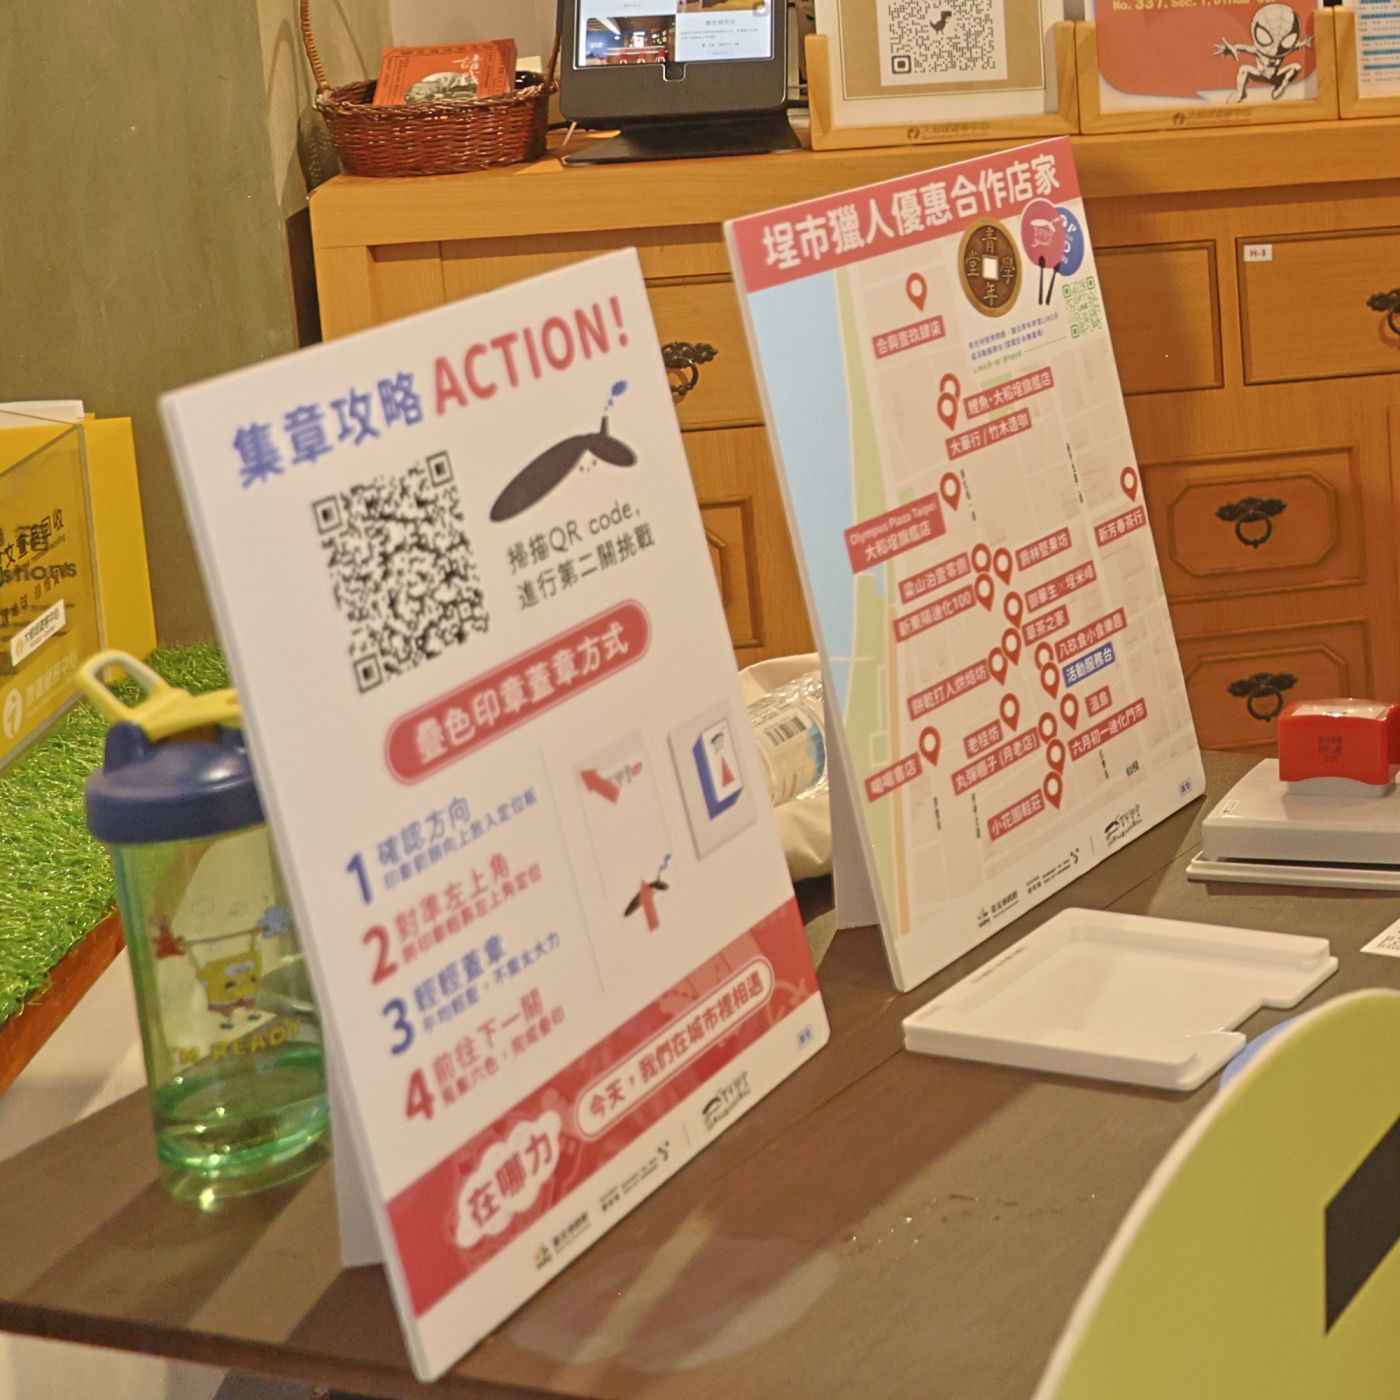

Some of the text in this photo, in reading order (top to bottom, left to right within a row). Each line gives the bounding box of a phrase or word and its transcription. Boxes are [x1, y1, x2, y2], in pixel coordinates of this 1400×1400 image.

[761, 152, 1062, 271] 埕市獵人優惠合作店家
[231, 295, 630, 489] 集章攻略 ACTION!
[516, 522, 657, 611] 進行第二關挑戰
[415, 621, 630, 765] 疊色印章蓋章方式
[1065, 647, 1115, 683] 活動服務台
[344, 795, 473, 907] 1 確認方向
[361, 852, 511, 987] 2 對準左上角
[209, 1018, 301, 1063] READY
[381, 933, 507, 1057] 3 輕輕蓋章
[404, 987, 545, 1121] 4 前往下一關
[465, 1131, 554, 1229] 在哪力
